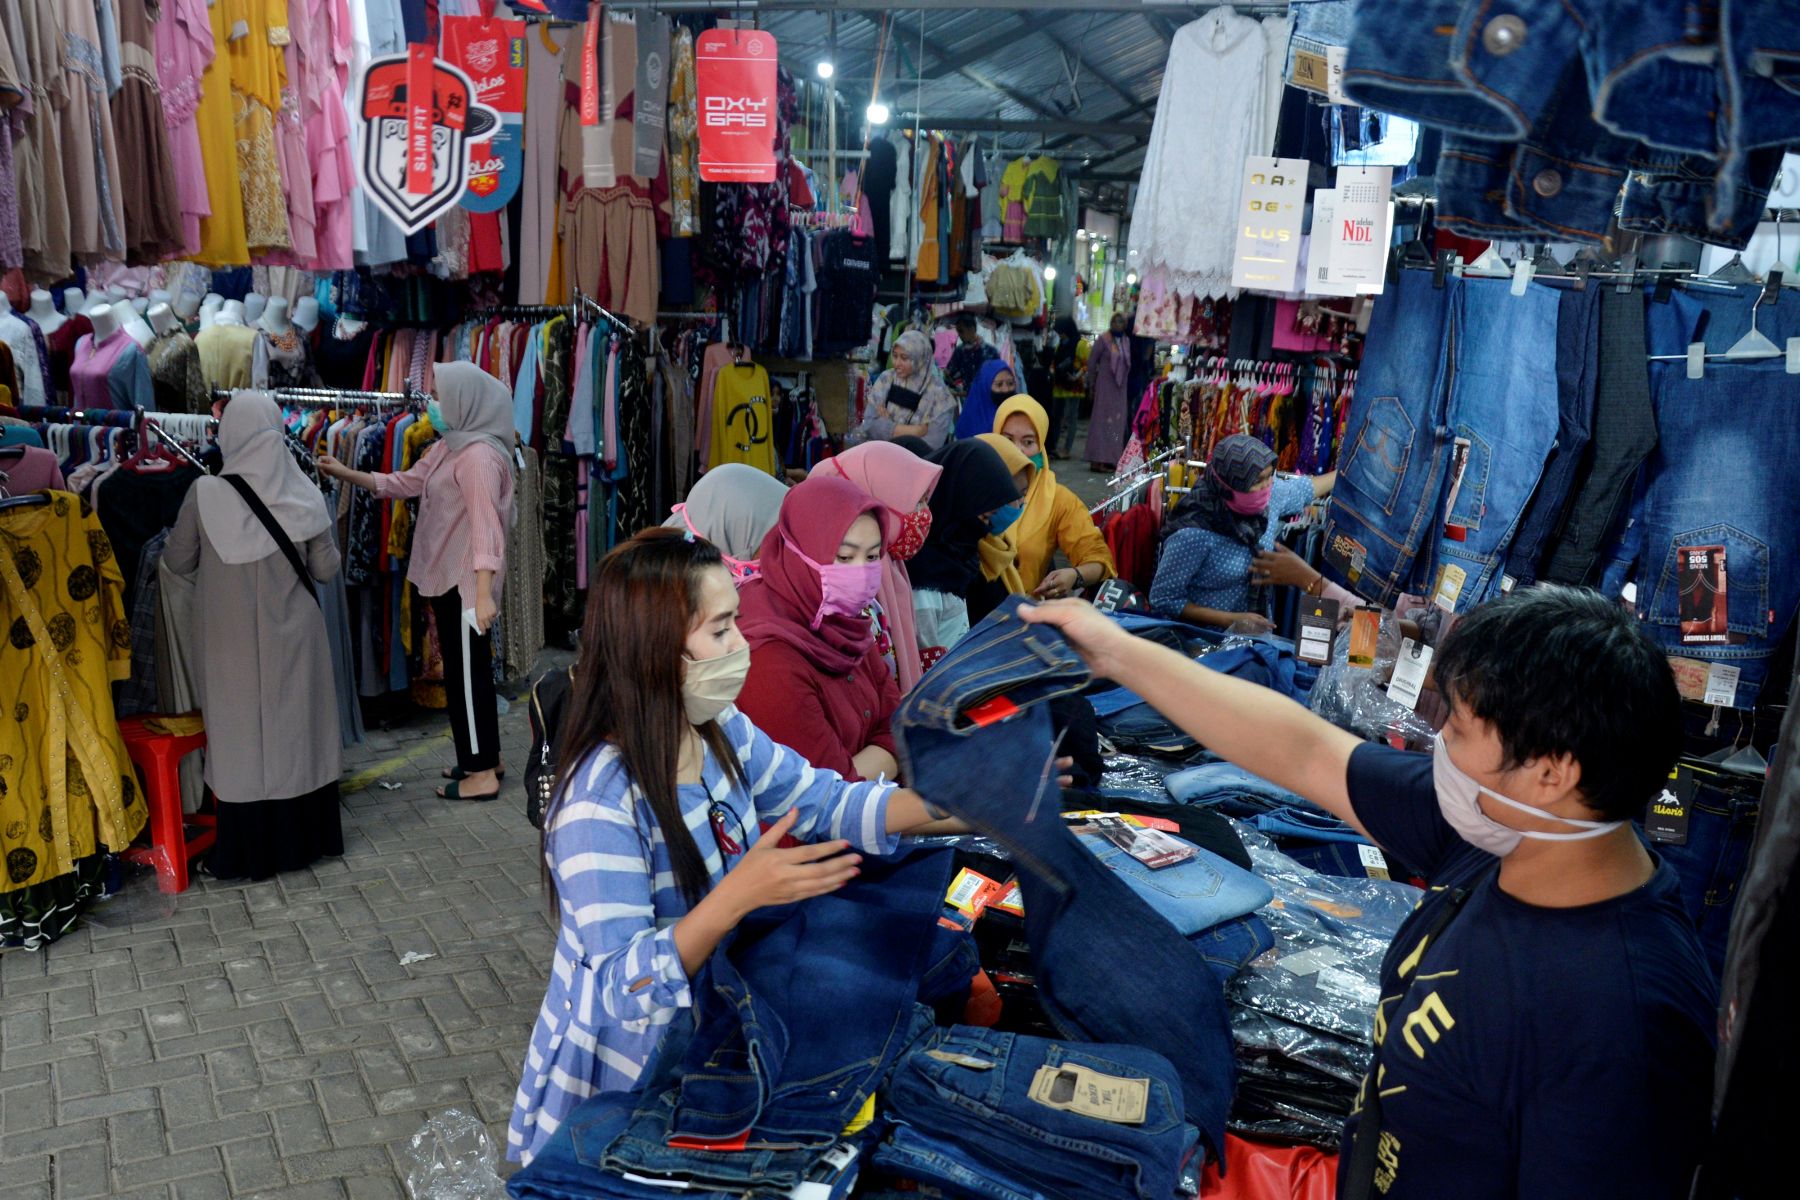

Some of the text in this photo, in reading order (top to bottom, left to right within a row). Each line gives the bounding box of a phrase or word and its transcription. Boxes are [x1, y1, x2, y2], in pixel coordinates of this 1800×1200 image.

[705, 96, 767, 111] OXY
[705, 112, 767, 127] GAS
[413, 107, 427, 172] SLIM FIT
[1244, 226, 1291, 242] LUS
[1342, 219, 1373, 242] NDL
[1689, 556, 1708, 564] 505
[1683, 634, 1726, 642] TIGHT STRAIGHT
